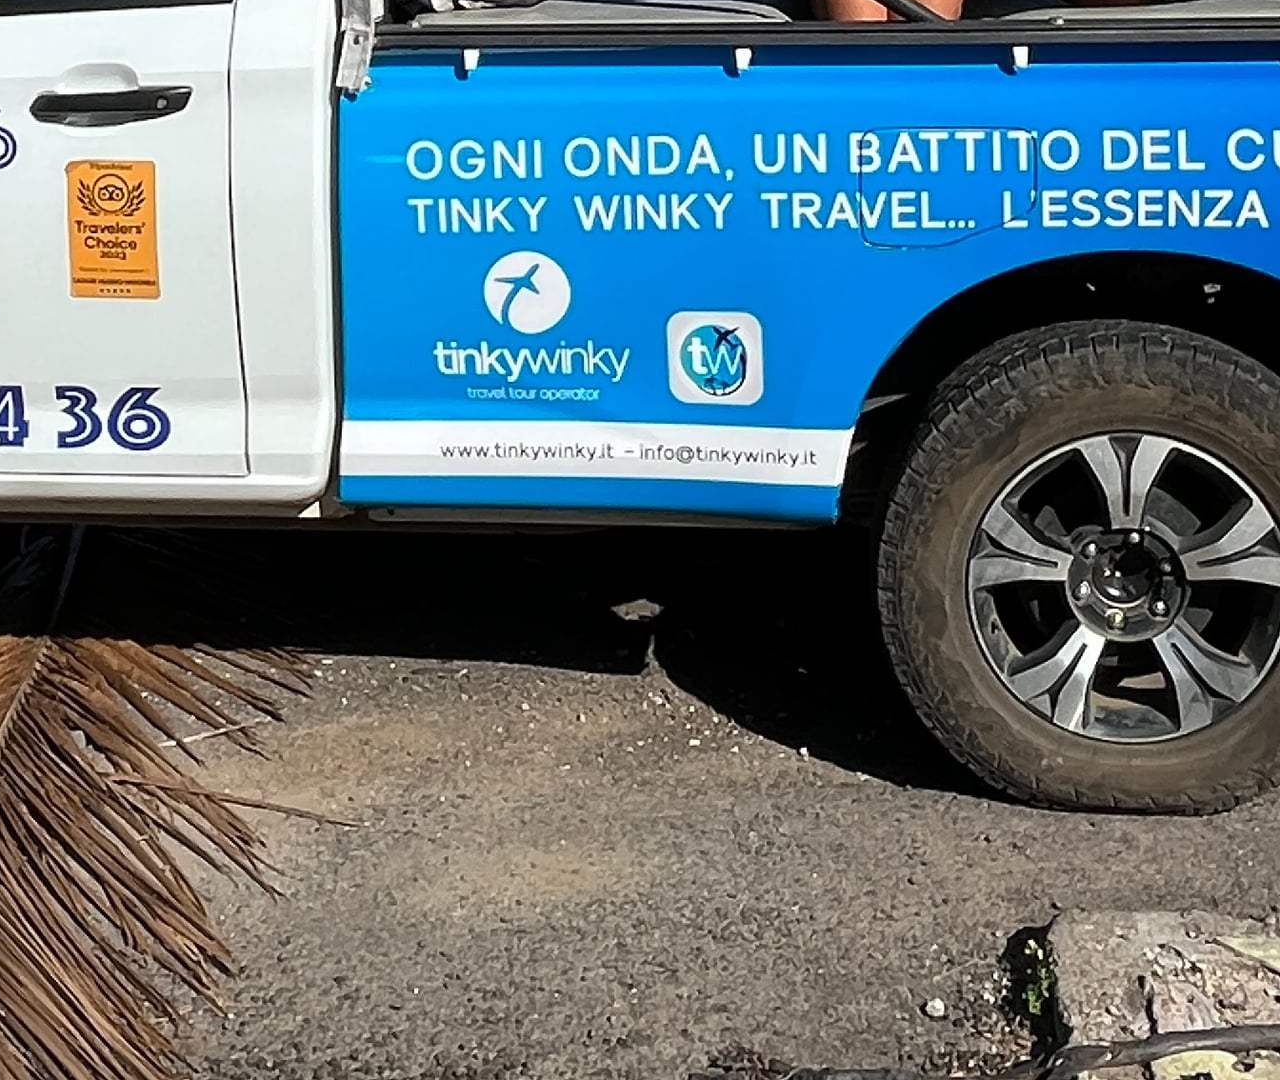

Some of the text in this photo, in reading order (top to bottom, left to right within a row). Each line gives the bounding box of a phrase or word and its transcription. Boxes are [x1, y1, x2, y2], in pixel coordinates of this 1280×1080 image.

[406, 138, 543, 181] OGNI
[564, 134, 734, 181] ONDA,
[753, 131, 826, 174] UN
[849, 129, 1081, 174] BATTITO
[1103, 129, 1204, 172] DEL
[407, 195, 547, 234] TINKY
[573, 192, 734, 232] WINKY
[761, 190, 976, 230] TRAVEL...
[1002, 188, 1269, 228] L'ESSENZA
[84, 236, 137, 250] Choice
[433, 340, 630, 383] tinkywinky
[467, 387, 600, 402] travel tour operator
[56, 386, 171, 451] 36
[440, 443, 614, 461] www.tinkywinky.it
[639, 445, 818, 467] info@tinkywinky.it
